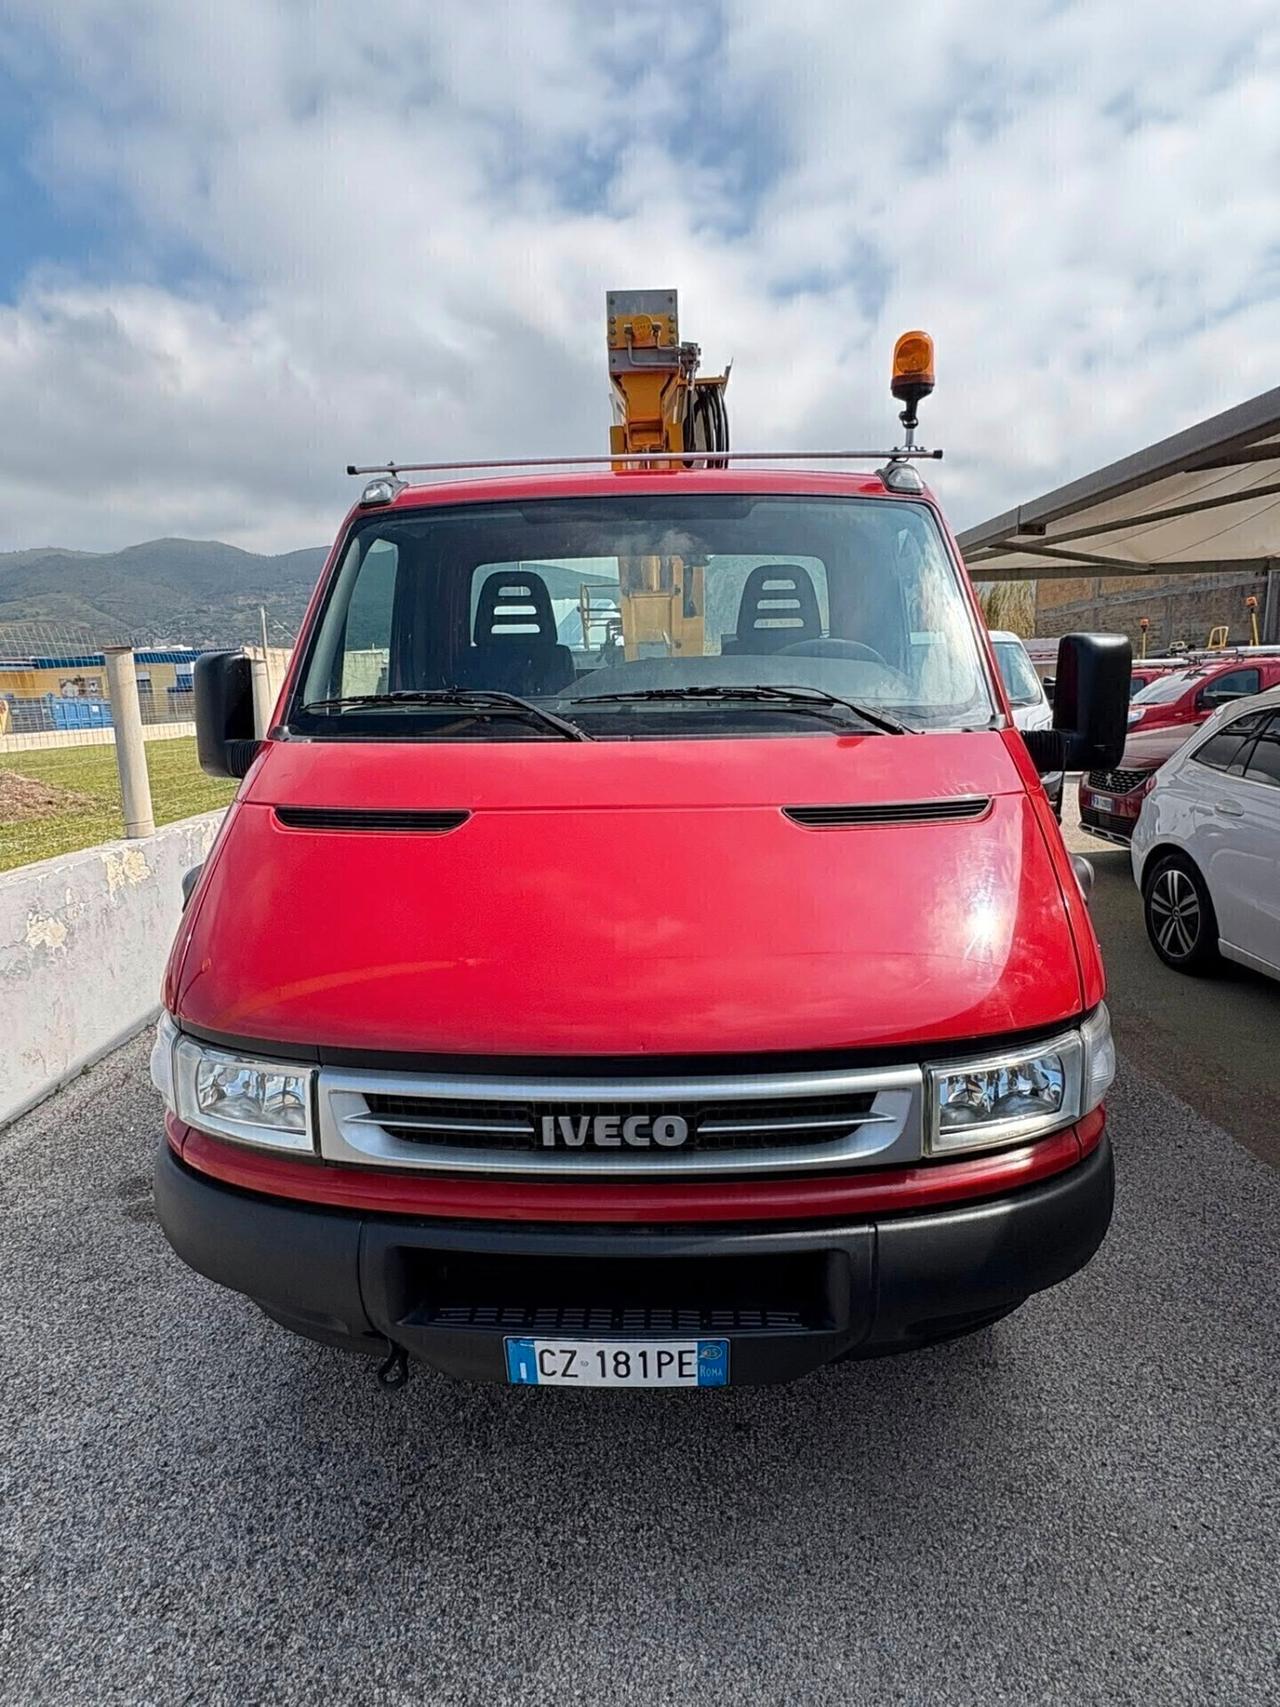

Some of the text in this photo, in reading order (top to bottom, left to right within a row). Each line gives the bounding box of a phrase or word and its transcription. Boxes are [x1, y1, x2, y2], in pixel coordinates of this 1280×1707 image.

[541, 1115, 688, 1147] IVECO
[538, 1348, 579, 1378] CZ
[596, 1349, 697, 1379] 181PE
